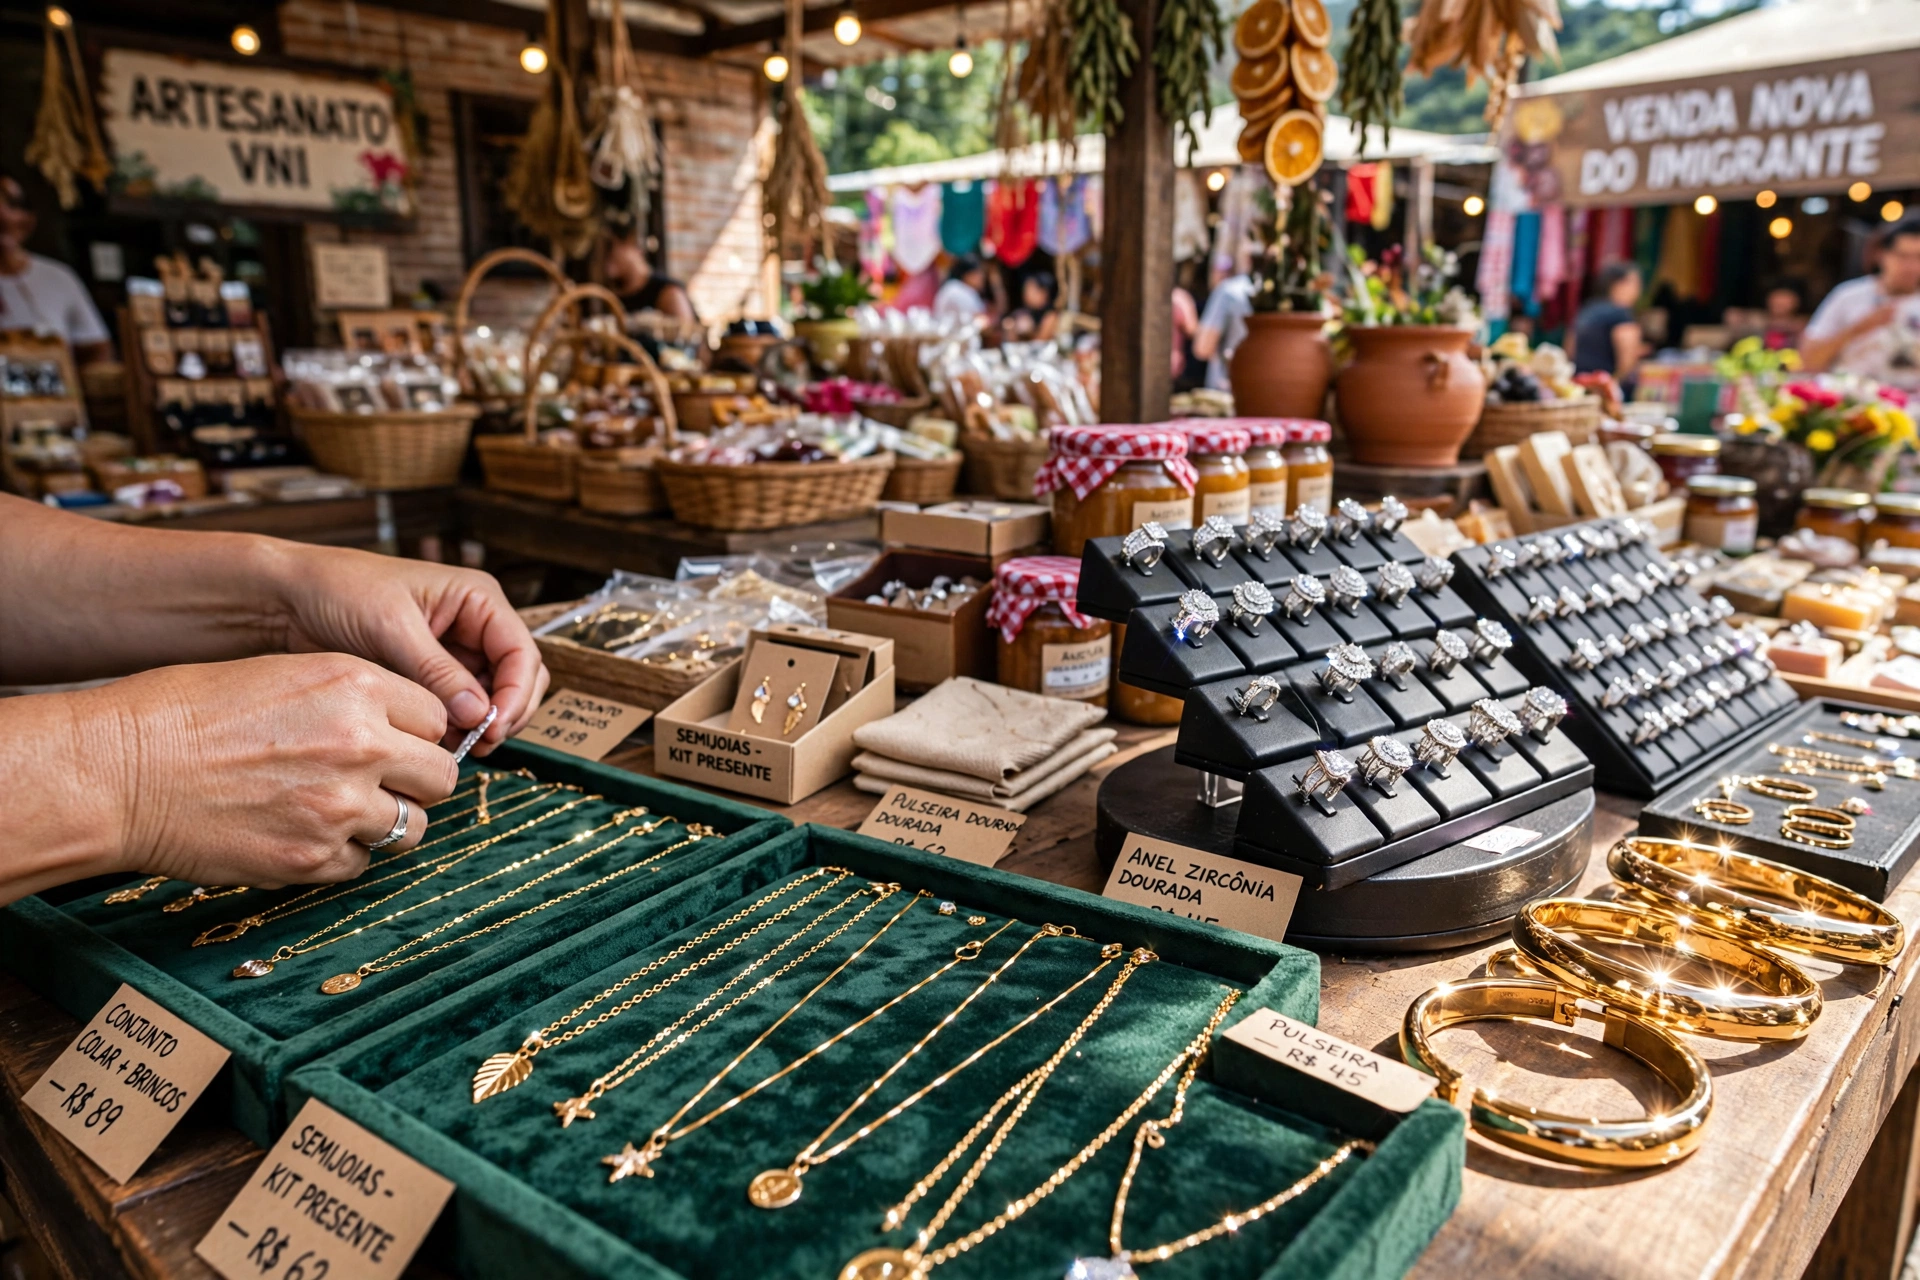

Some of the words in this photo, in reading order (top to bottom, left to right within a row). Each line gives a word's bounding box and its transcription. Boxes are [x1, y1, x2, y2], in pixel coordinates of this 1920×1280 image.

[130, 74, 389, 145] ARTESANATO
[1603, 86, 1738, 143] VENDA
[1750, 70, 1873, 130] NOVA
[229, 138, 311, 188] VNI
[1580, 146, 1639, 195] DO
[1646, 123, 1886, 190] IMIGRANTE
[669, 746, 693, 764] KIT
[697, 752, 772, 782] PRESENTE
[676, 727, 751, 756] SEMIJOIAS
[875, 811, 942, 836] DOURADA
[891, 792, 960, 821] PULSEIRA
[1127, 847, 1176, 875] ANEL
[1117, 869, 1202, 906] DOURADA
[105, 1003, 178, 1058] CONJUNTO
[1269, 1019, 1380, 1073] PULSEIRA
[75, 1029, 123, 1071] COLAR
[123, 1062, 187, 1113] BRINCOS
[1286, 1047, 1318, 1068] R$
[1329, 1063, 1368, 1087] 45
[60, 1082, 98, 1118] R$
[84, 1097, 124, 1136] 89
[291, 1124, 380, 1198] SEMIJOIAS
[261, 1162, 302, 1203] KIT
[294, 1182, 396, 1264] PRESENTE
[247, 1226, 291, 1276] R$
